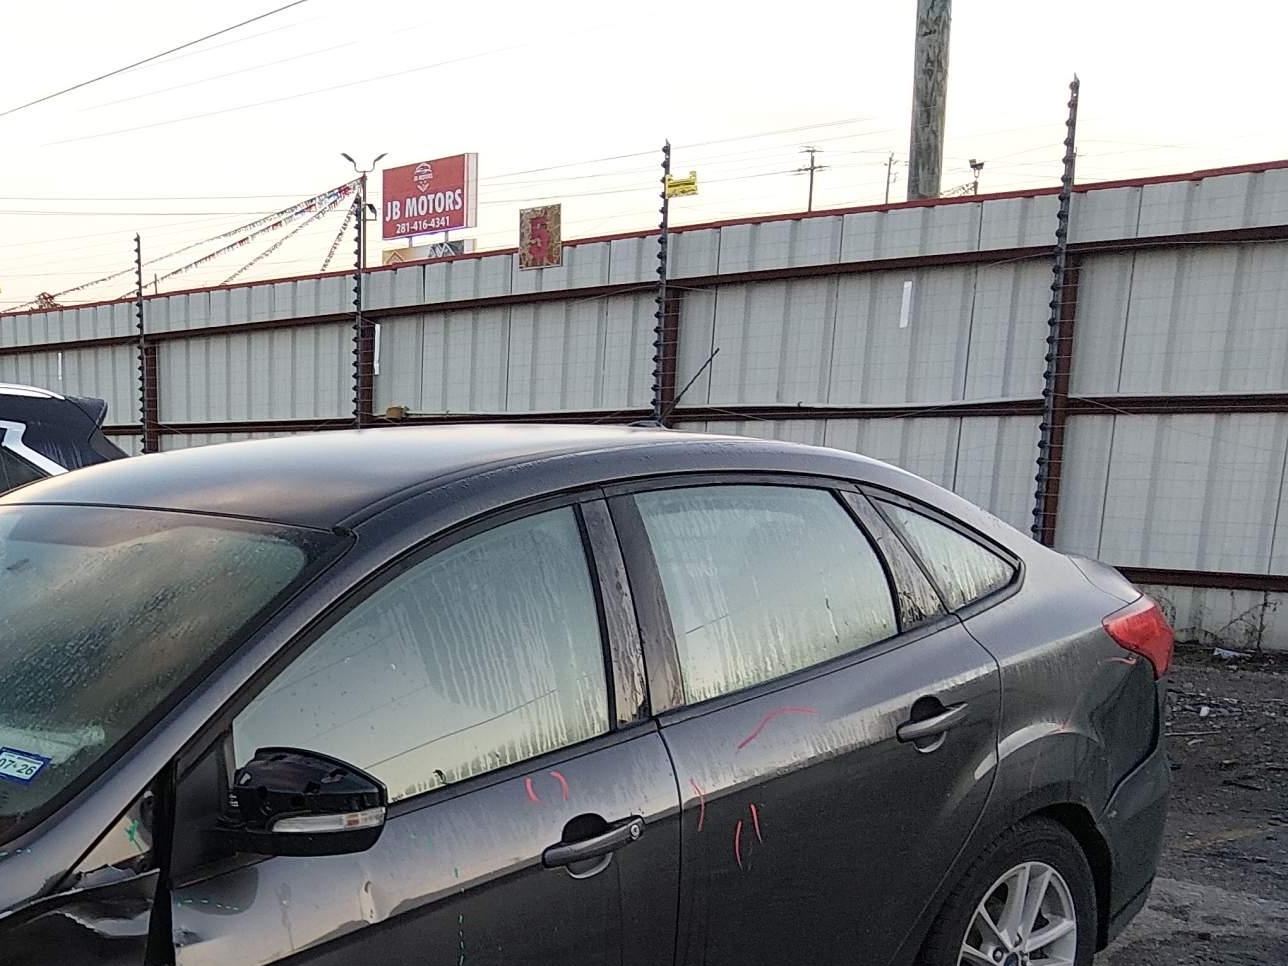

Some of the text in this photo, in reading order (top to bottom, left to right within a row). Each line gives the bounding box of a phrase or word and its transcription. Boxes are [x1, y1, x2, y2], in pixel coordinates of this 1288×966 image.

[385, 190, 462, 222] JB MOTORS
[395, 215, 450, 235] 281-416-4341
